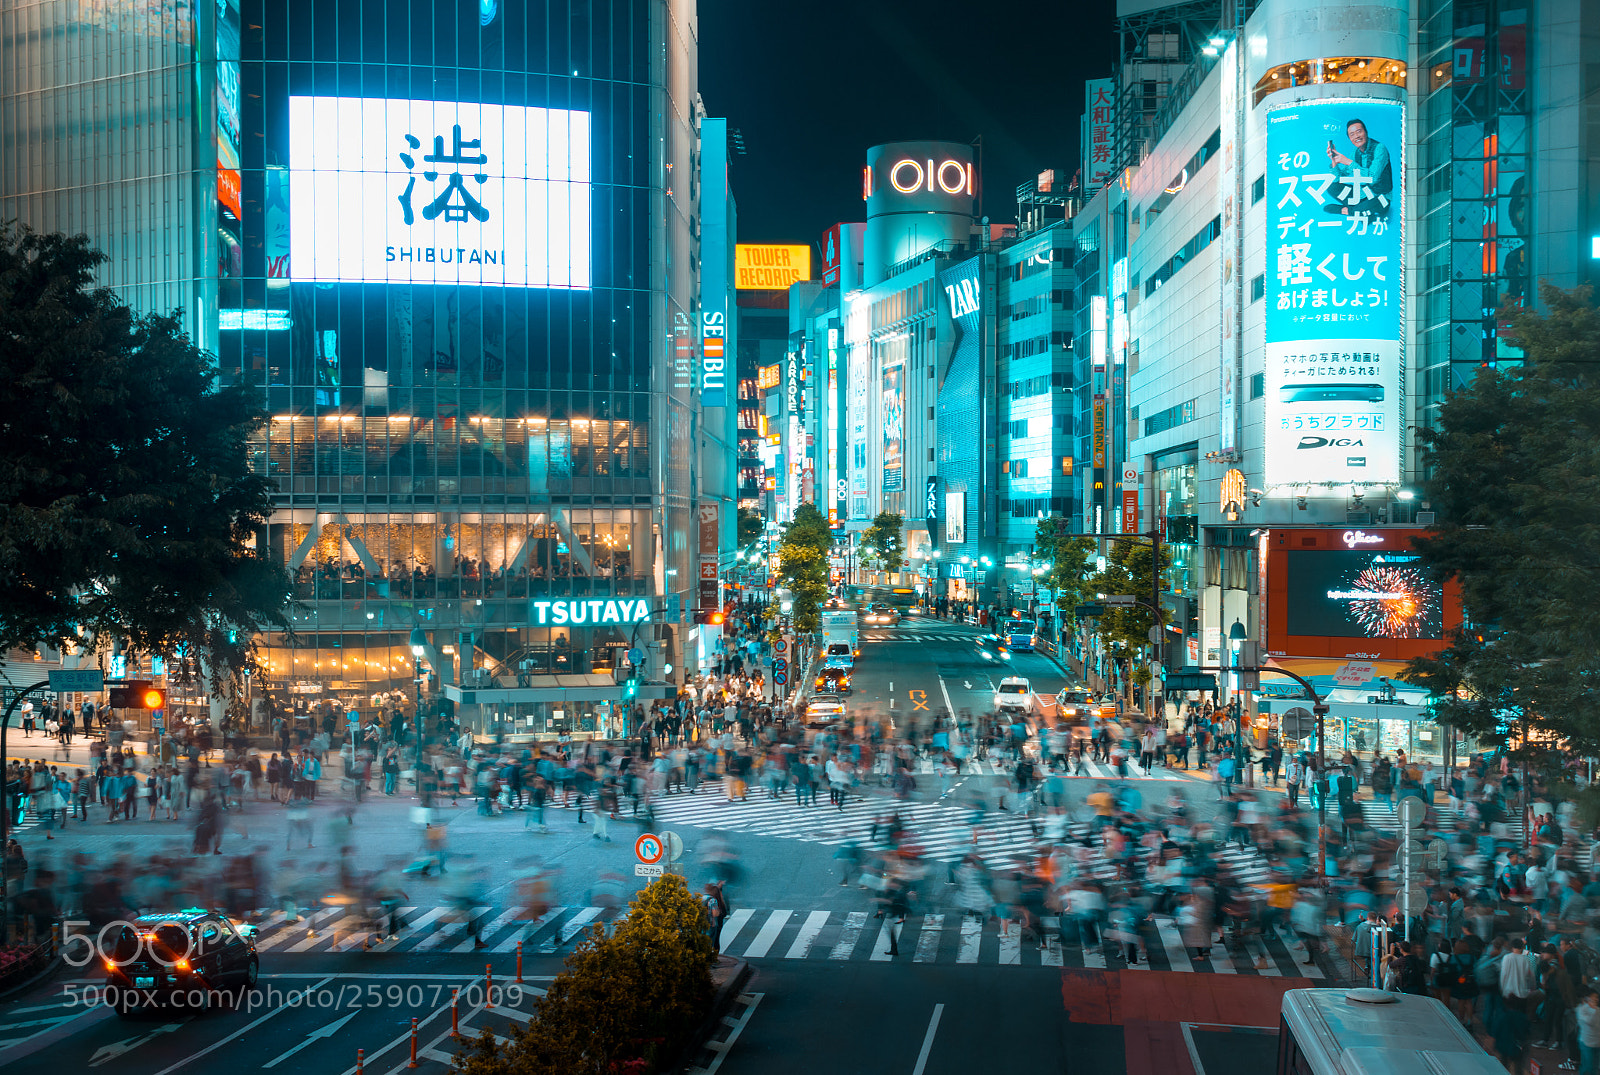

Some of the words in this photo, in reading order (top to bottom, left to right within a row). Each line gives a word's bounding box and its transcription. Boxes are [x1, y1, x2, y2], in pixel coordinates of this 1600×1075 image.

[1092, 87, 1111, 164] 大和証券
[1271, 115, 1299, 124] Panasonic
[1278, 151, 1311, 171] その
[891, 159, 972, 195] OIOI
[1277, 169, 1389, 210] スマホ、
[1277, 210, 1388, 239] ディーガが
[386, 246, 505, 265] SHIBUTANI
[744, 248, 791, 266] TOWER
[1277, 243, 1388, 286] 軽くして
[739, 268, 801, 286] RECORDS
[1277, 288, 1388, 310] あげましょう!
[703, 312, 724, 388] SEIBU
[1283, 353, 1380, 363] スマホの写真や動画は
[788, 352, 798, 411] KARAOKE
[1281, 415, 1383, 429] おうちクラウド
[1297, 436, 1364, 449] DIGA
[927, 483, 937, 518] ZARA
[1343, 531, 1384, 548] Glico
[950, 563, 964, 578] ZARA
[534, 600, 650, 624] TSUTAYA
[637, 867, 662, 875] ここから
